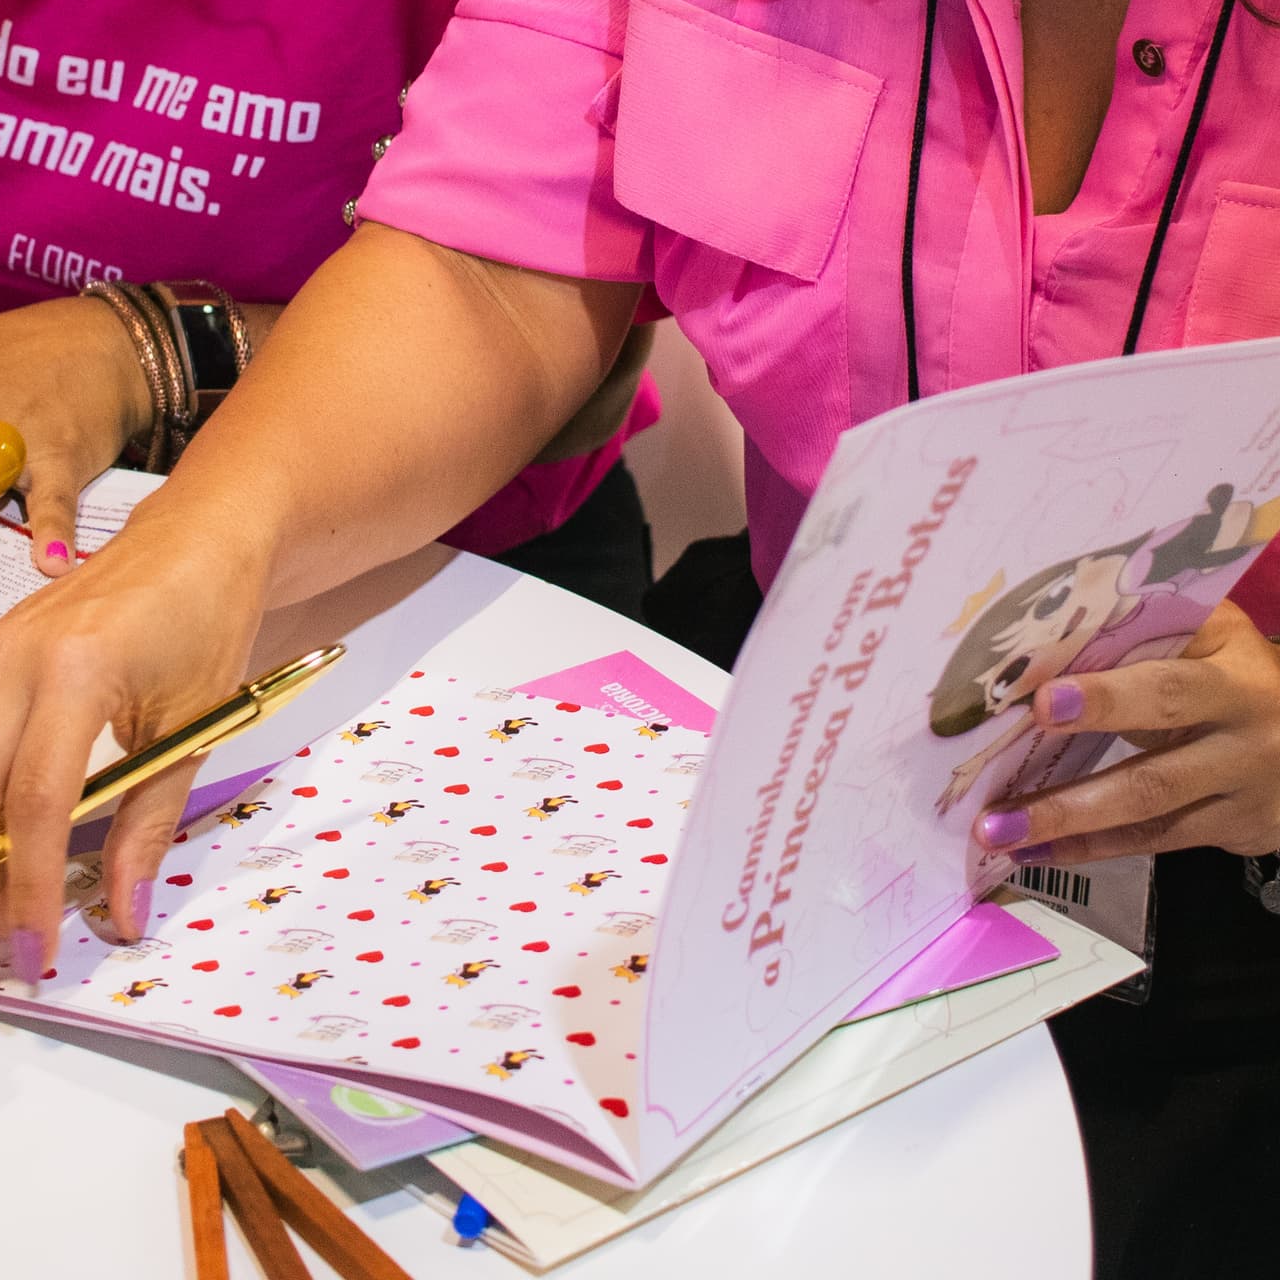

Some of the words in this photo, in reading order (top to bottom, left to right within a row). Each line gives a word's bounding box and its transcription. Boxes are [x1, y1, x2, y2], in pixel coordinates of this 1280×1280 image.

[56, 52, 124, 103] eu
[133, 63, 198, 120] me
[201, 85, 322, 144] amo
[861, 455, 979, 616] Botas
[831, 625, 889, 692] de
[721, 662, 829, 933] Caminhando
[824, 566, 874, 653] com
[747, 704, 854, 961] Princesa
[763, 958, 781, 988] a
